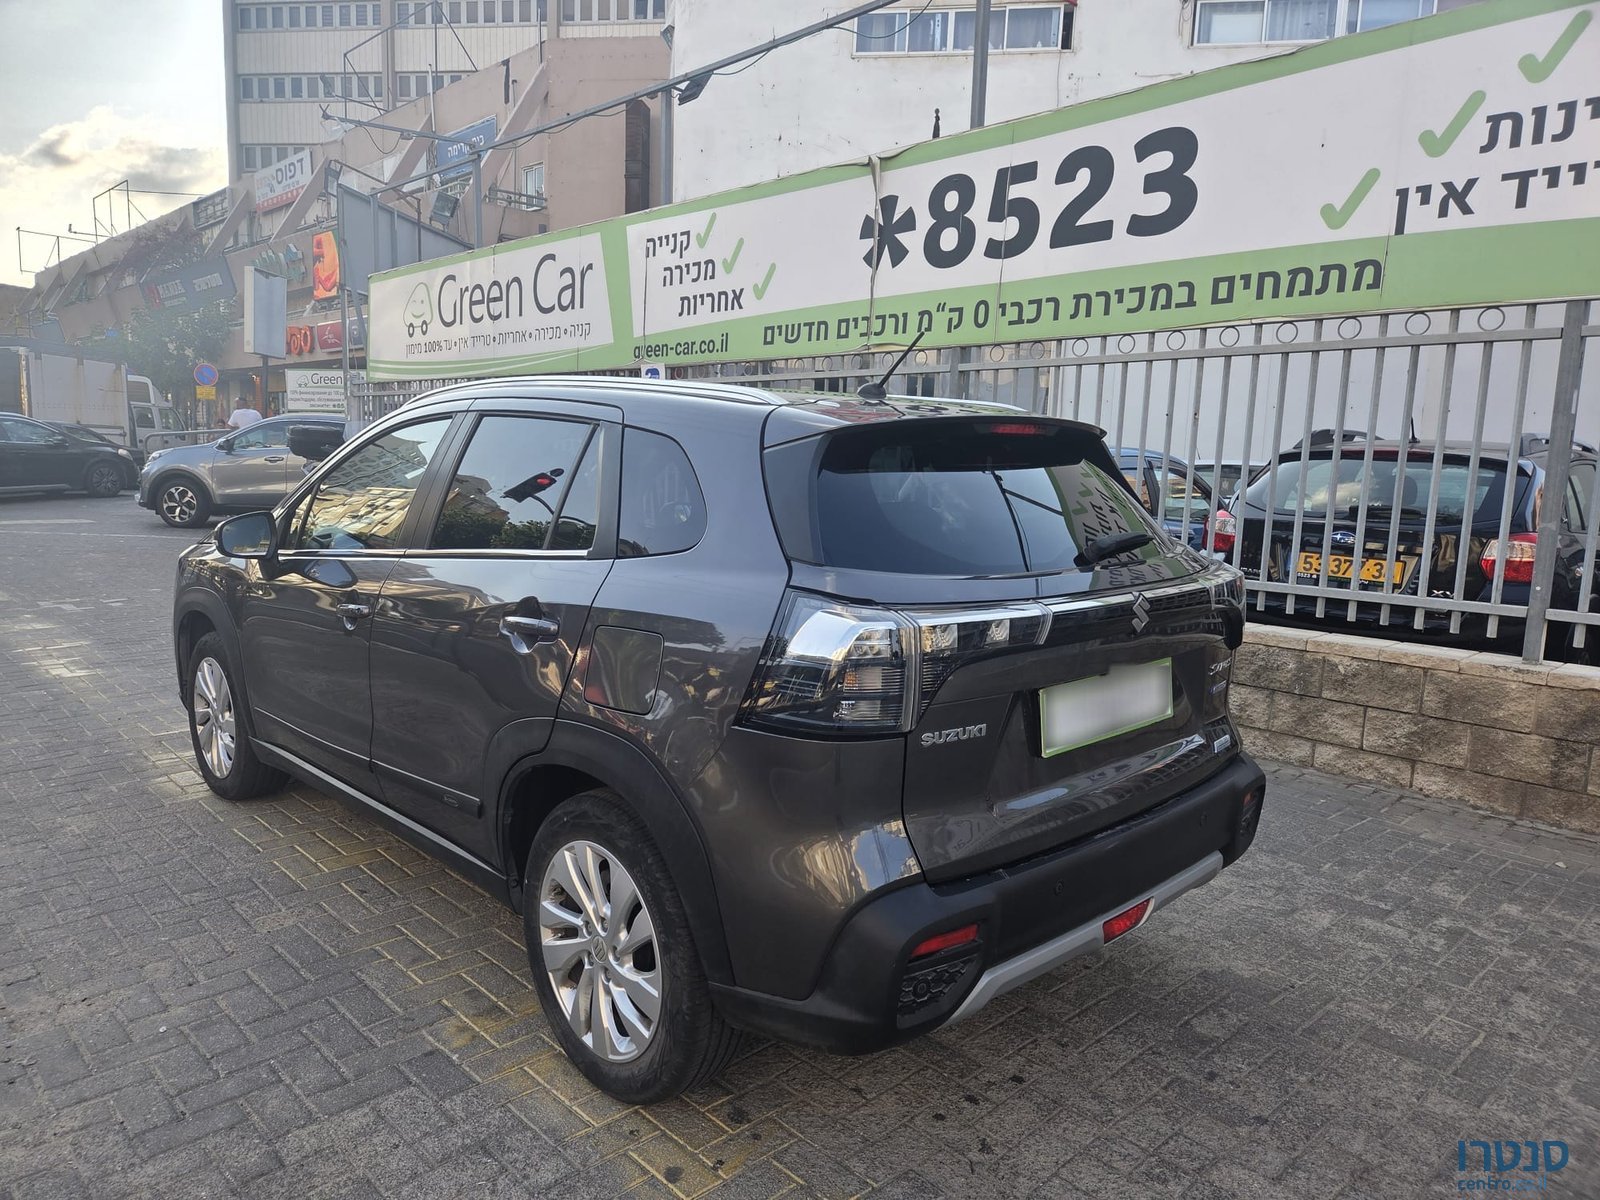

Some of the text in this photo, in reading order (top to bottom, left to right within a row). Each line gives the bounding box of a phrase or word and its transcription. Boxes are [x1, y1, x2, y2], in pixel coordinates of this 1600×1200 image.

[275, 157, 304, 184] דפוס
[1394, 160, 1600, 236] ייד אין
[646, 230, 691, 258] קנייה
[662, 258, 716, 287] מכירה
[1210, 259, 1383, 305] מתמחים
[438, 253, 593, 328] Green Car
[678, 287, 745, 317] אחריות
[1069, 281, 1197, 320] במכירת
[973, 299, 990, 328] 0
[998, 296, 1060, 326] רכבי
[498, 329, 527, 345] אחריות
[534, 326, 561, 342] מכירה
[569, 322, 591, 341] קניה
[762, 320, 829, 346] חדשים
[836, 312, 908, 339] ורכבים
[424, 340, 443, 353] 100%
[458, 337, 469, 352] אין
[471, 335, 491, 347] טרייד
[311, 373, 343, 385] Green
[920, 723, 987, 747] SUZUKI
